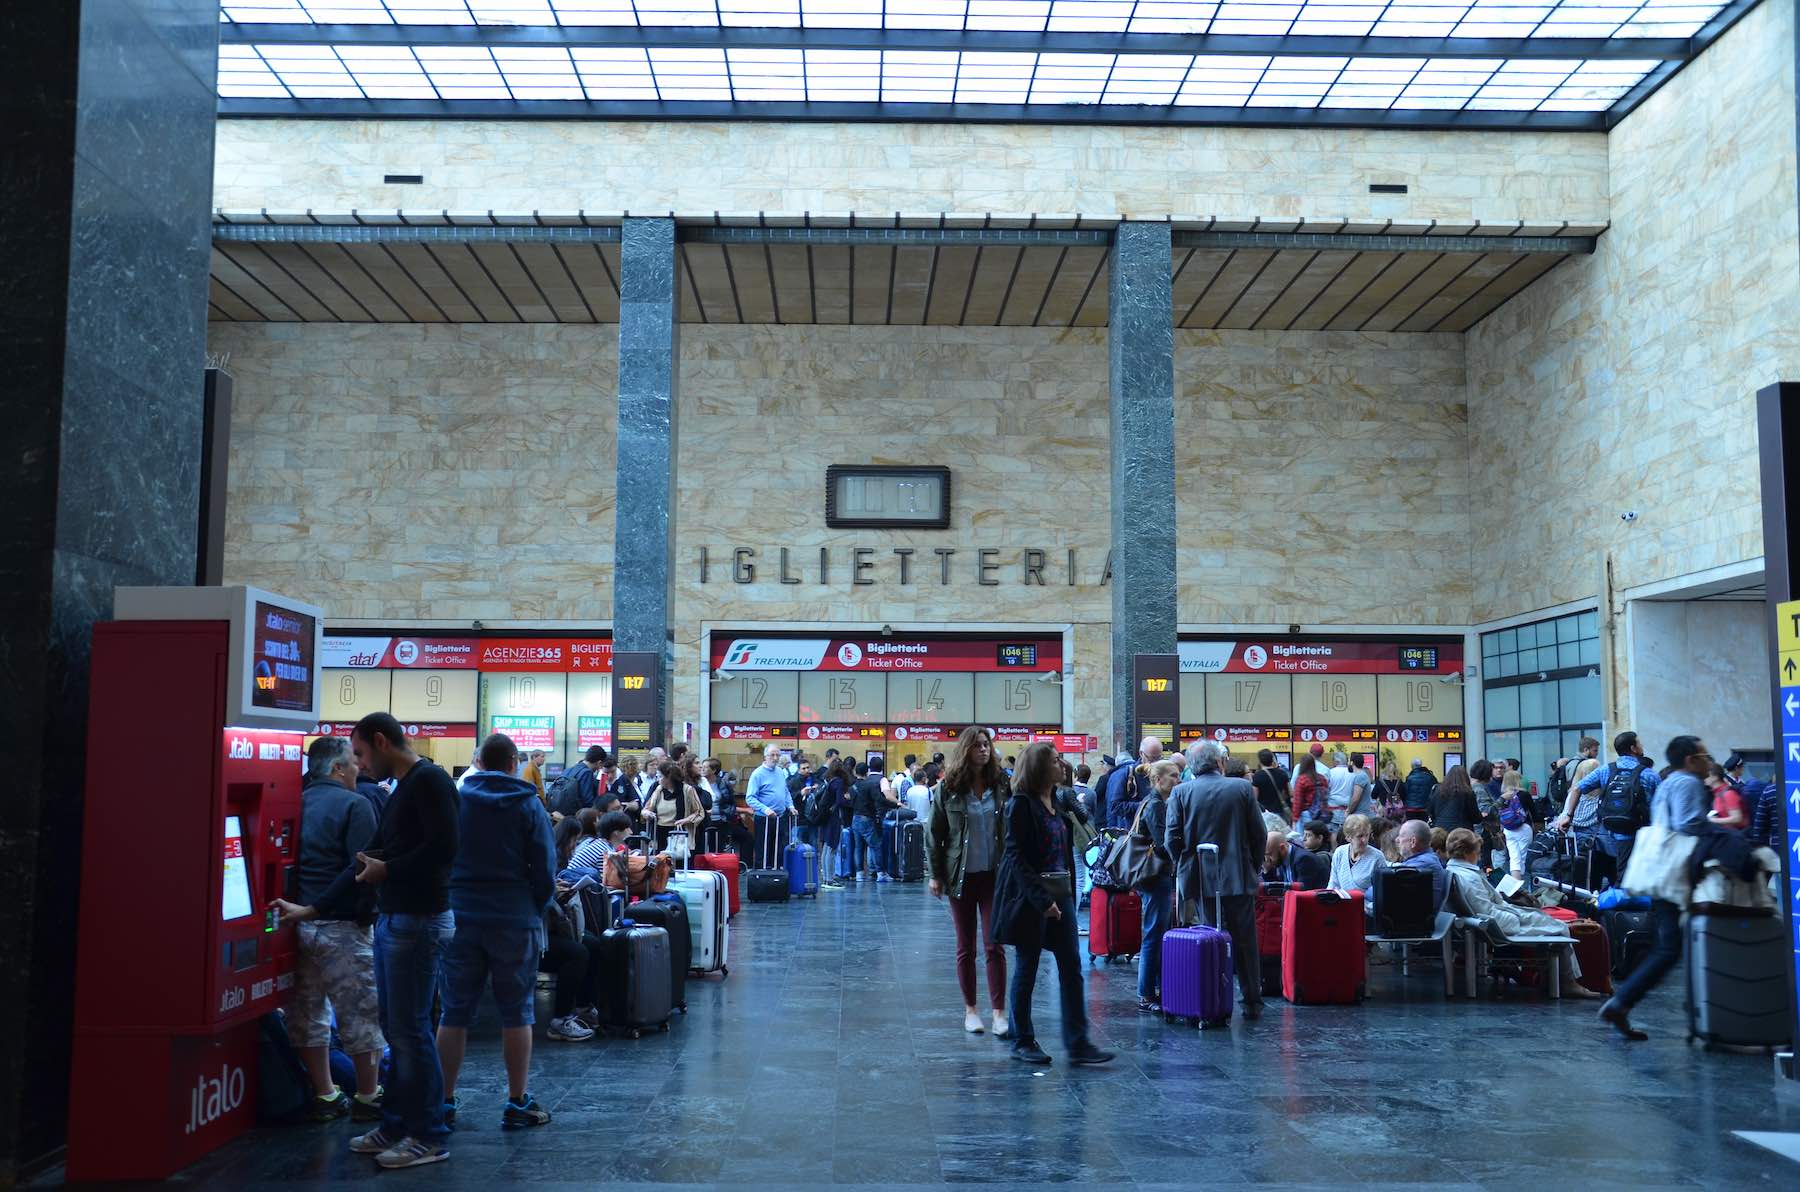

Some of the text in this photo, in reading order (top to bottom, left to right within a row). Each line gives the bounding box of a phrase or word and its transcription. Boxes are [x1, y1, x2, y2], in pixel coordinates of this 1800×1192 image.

[424, 644, 471, 655] Biglietteria
[483, 647, 562, 659] AGENZIE365
[867, 643, 928, 655] Biglietteria
[1002, 648, 1022, 657] 1046
[1273, 645, 1332, 657] Biglietteria
[1403, 651, 1422, 659] 1046
[348, 652, 379, 666] ataf
[424, 655, 467, 665] Ticket Office
[754, 657, 814, 666] TRENITALIA
[867, 658, 924, 668] Ticket Office
[1179, 660, 1220, 669] NITALIA
[1273, 660, 1328, 670] Ticket Office
[623, 676, 645, 690] 11:17
[1147, 678, 1168, 692] 11:17
[340, 675, 356, 706] 8
[426, 676, 443, 707] 9
[510, 676, 536, 708] 10
[741, 677, 768, 709] 12
[829, 678, 857, 710] 13
[916, 679, 945, 710] 14
[1004, 679, 1032, 711] 15
[1235, 681, 1262, 712] 17
[1322, 681, 1348, 712] 18
[1406, 682, 1434, 712] 19
[494, 717, 513, 728] SKIP
[515, 718, 530, 728] THE
